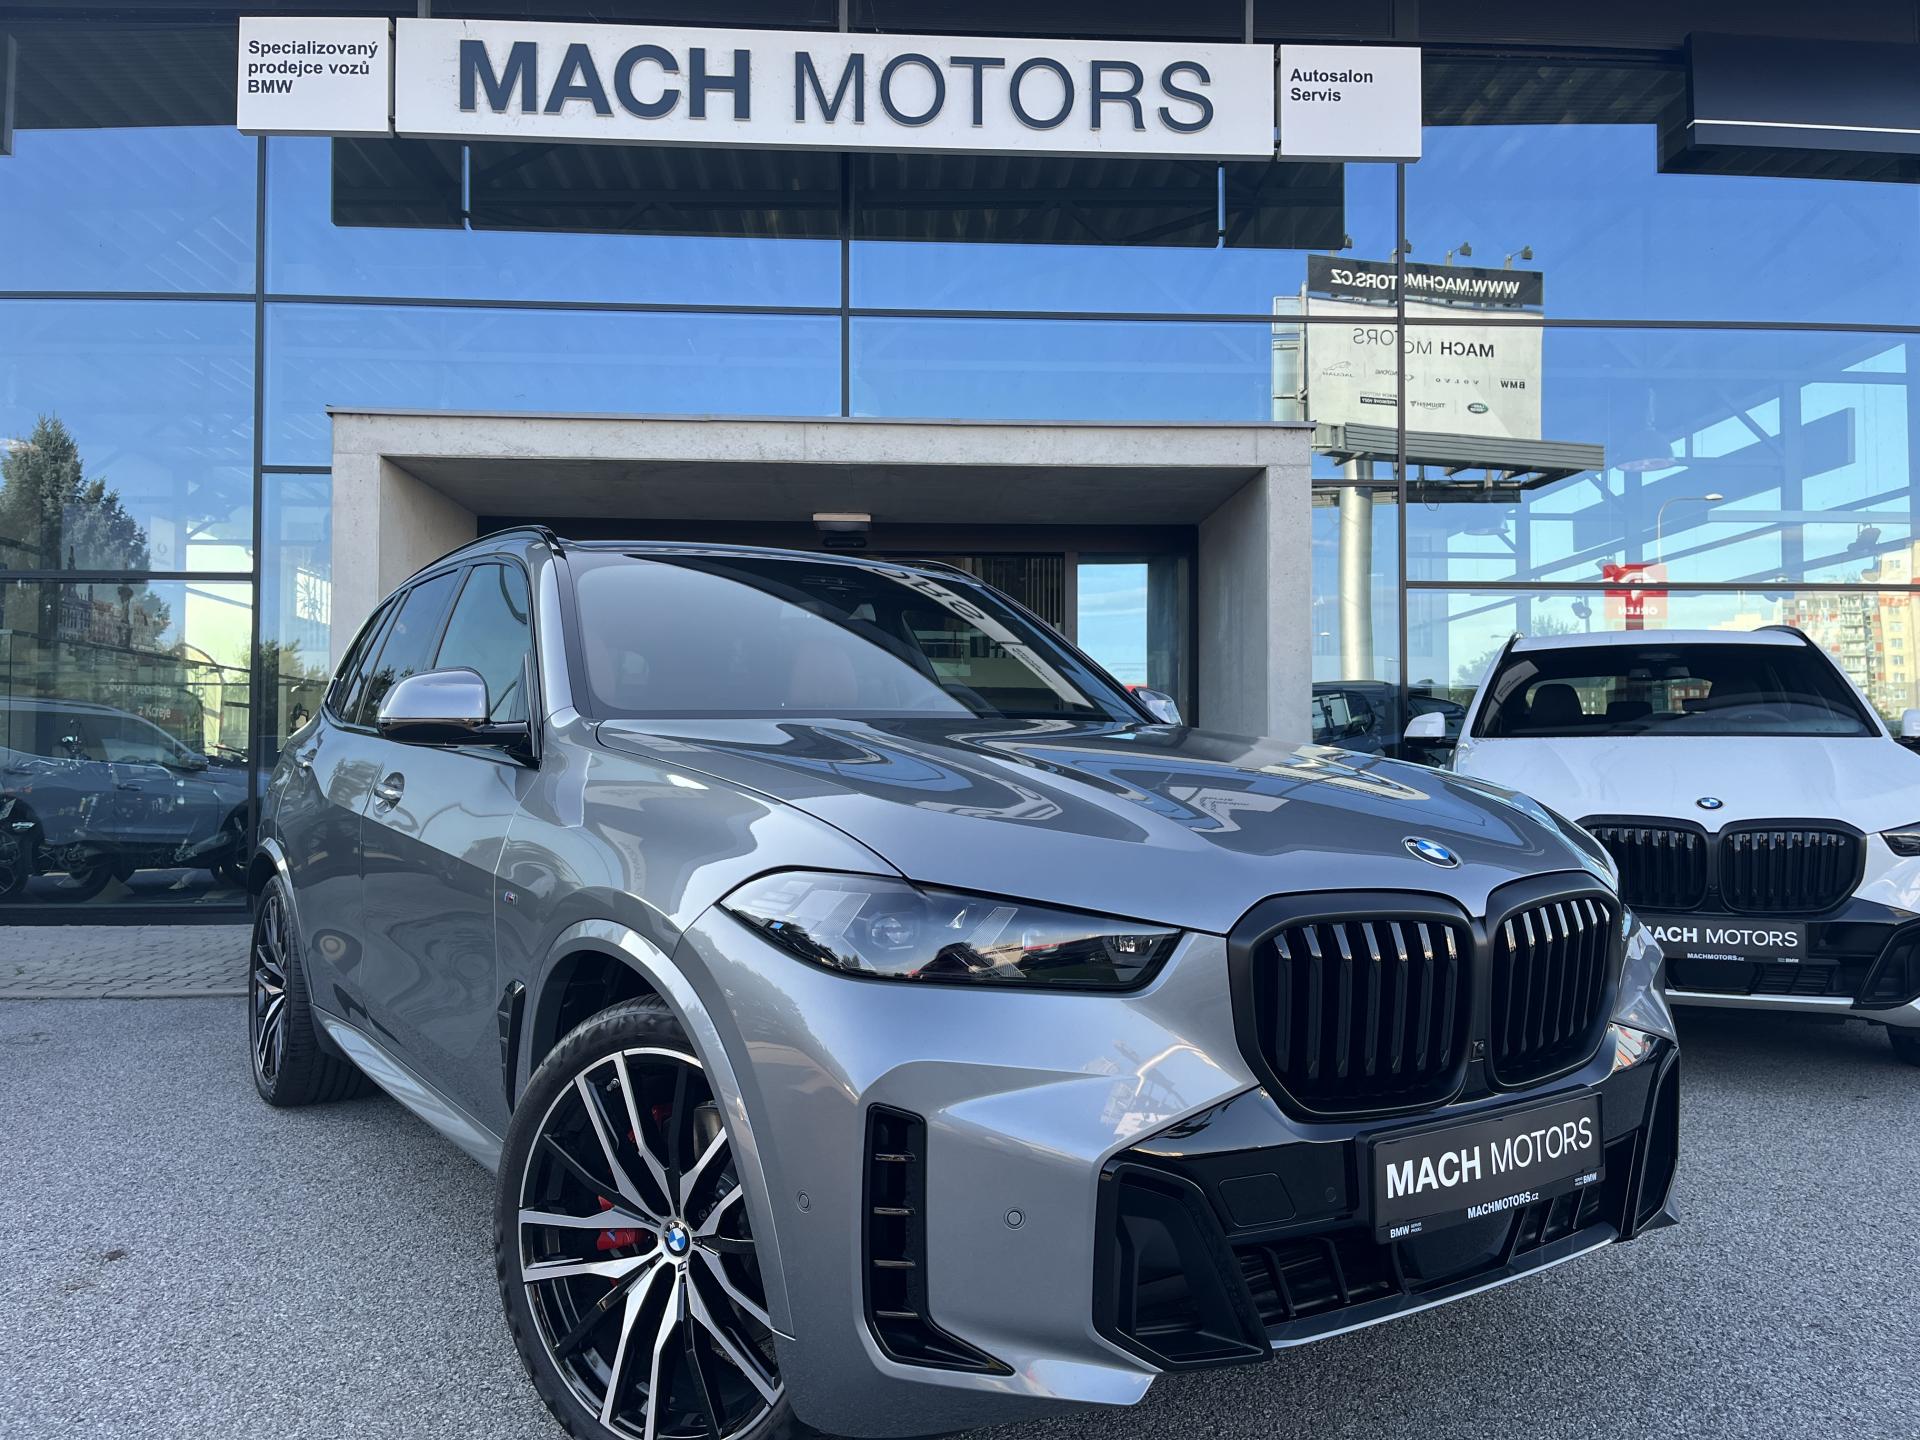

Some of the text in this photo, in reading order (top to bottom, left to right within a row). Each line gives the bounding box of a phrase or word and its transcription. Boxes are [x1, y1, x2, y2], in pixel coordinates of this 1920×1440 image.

[248, 40, 378, 59] Specializovaný
[248, 60, 370, 77] prodejce vozů
[1290, 68, 1374, 84] Autosalon
[248, 79, 293, 94] BMW
[459, 39, 1214, 134] MACH MOTORS
[1290, 86, 1342, 103] Servis
[1650, 926, 1798, 947] ACH MOTORS
[1386, 1116, 1593, 1199] MACH MOTORS
[1467, 1190, 1539, 1220] MACHMOTORS.cz
[1390, 1224, 1410, 1239] BMW
